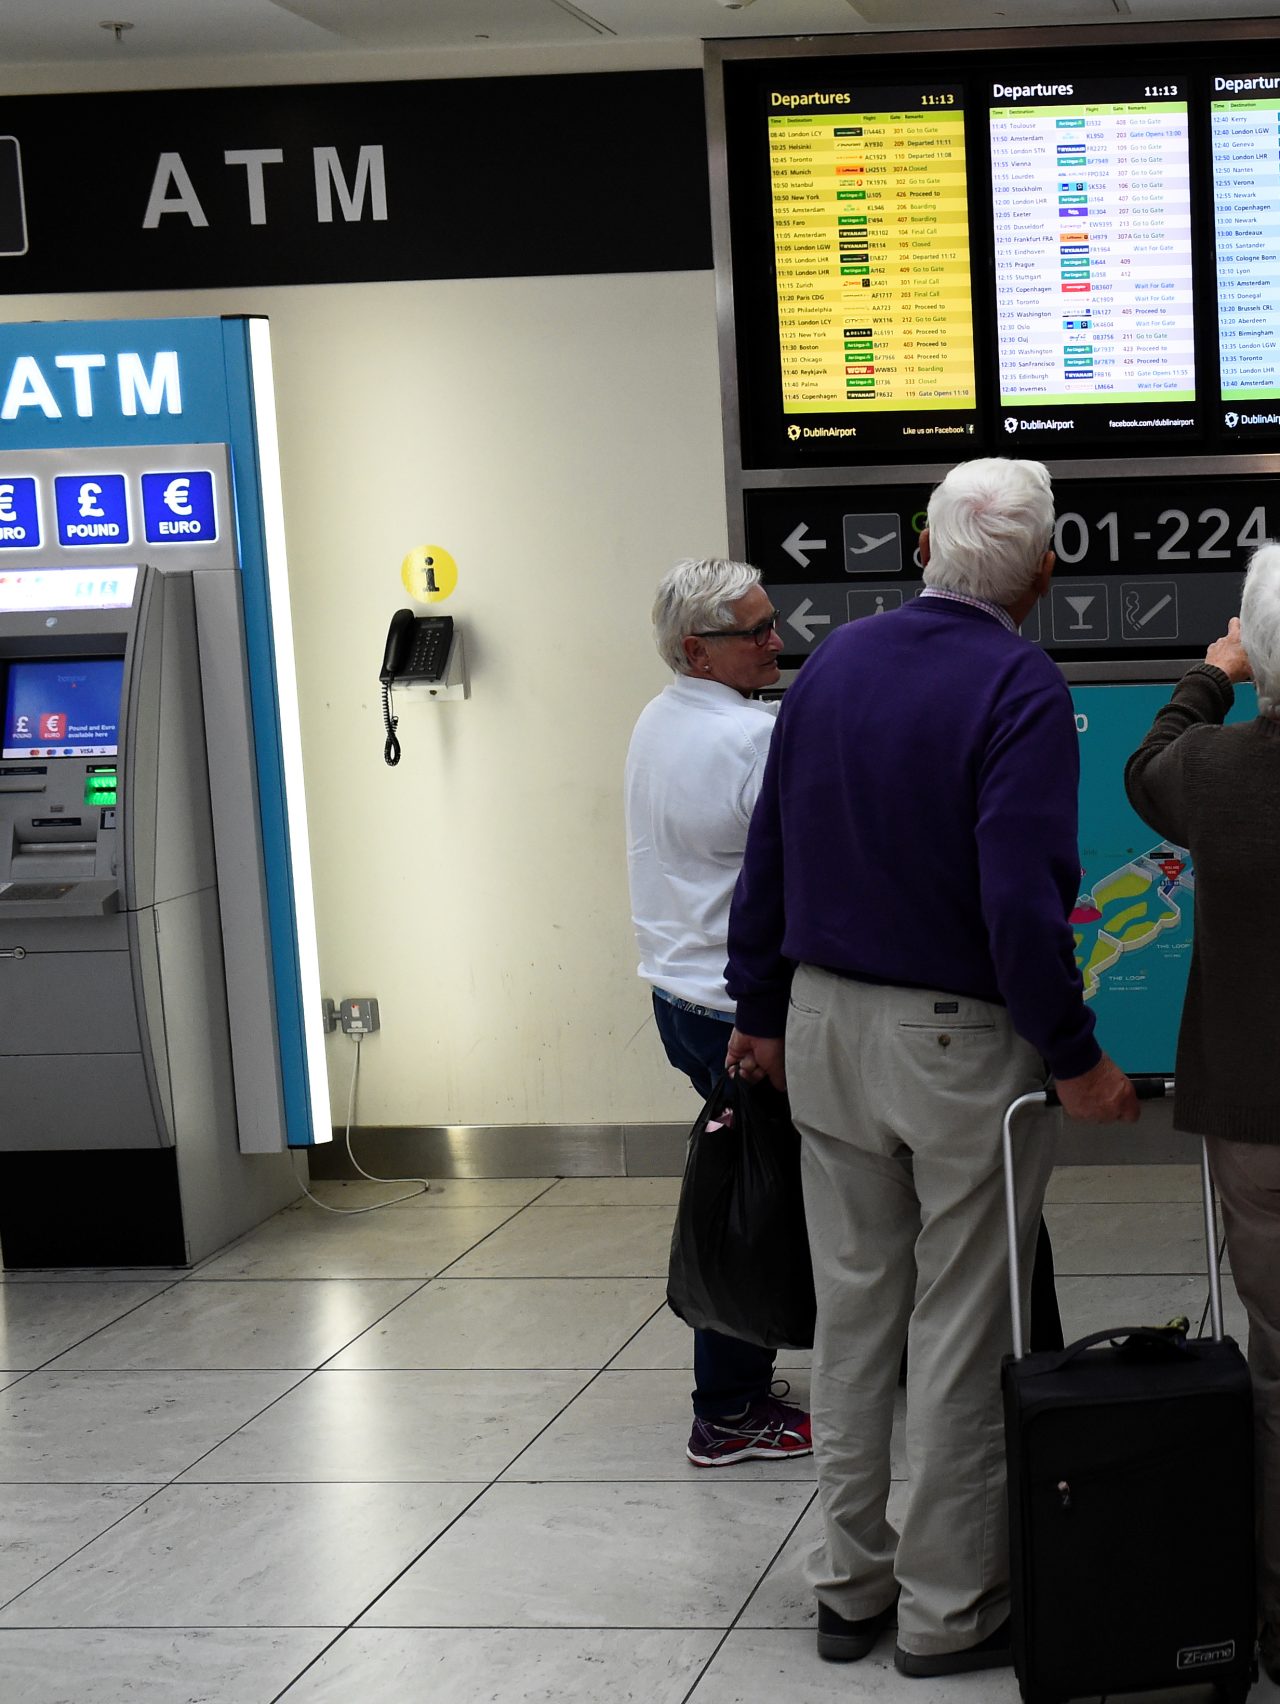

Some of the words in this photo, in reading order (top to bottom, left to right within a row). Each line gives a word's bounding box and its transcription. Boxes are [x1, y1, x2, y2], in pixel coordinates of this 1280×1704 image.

[993, 84, 1073, 100] Departures
[1145, 86, 1178, 96] 11:13
[771, 92, 851, 108] Departures
[921, 95, 954, 105] 11:13
[142, 144, 389, 229] ATM
[1, 351, 183, 421] ATM
[1021, 420, 1073, 431] DublinAirport
[1109, 419, 1194, 427] facebook.com/dublinairport
[804, 427, 856, 438] DublinAirport
[903, 427, 915, 435] Like
[935, 426, 964, 434] Facebook
[78, 483, 104, 518] £
[163, 478, 193, 515] €
[67, 523, 119, 537] POUND
[159, 520, 201, 534] EURO
[1051, 506, 1273, 563] 01-224
[1184, 1649, 1231, 1664] ZFrame
